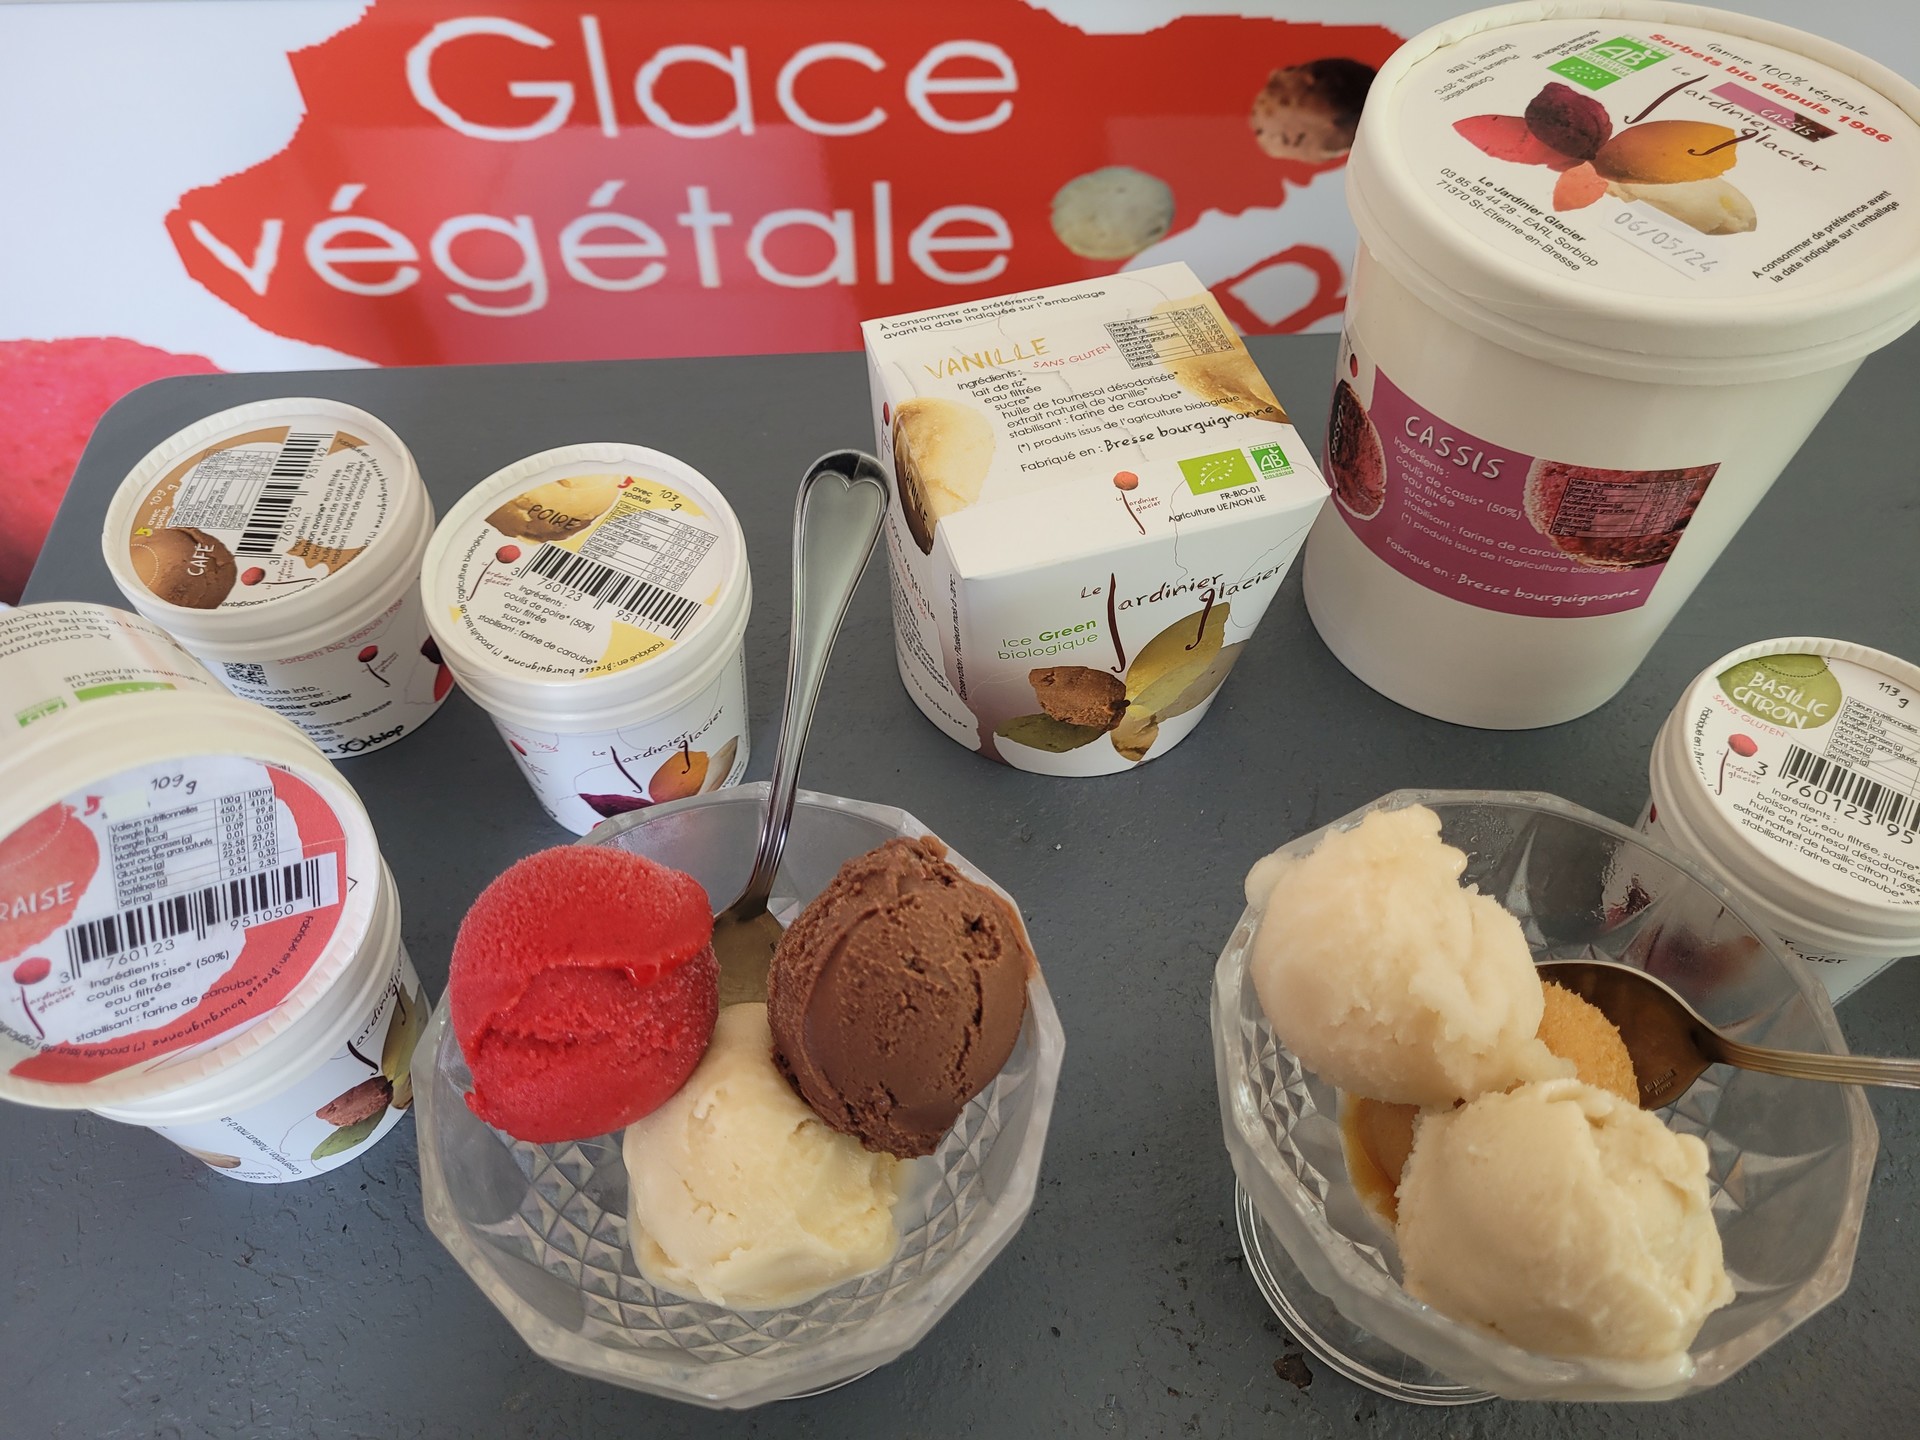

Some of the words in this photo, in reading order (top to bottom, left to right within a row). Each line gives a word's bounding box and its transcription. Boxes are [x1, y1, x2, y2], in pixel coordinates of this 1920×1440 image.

[407, 14, 1019, 141] Glace
[1649, 33, 1723, 68] Sorbets
[1725, 65, 1757, 82] bio
[1762, 81, 1831, 116] depuis
[1837, 114, 1893, 144] 1986
[1671, 66, 1691, 77] Le
[1707, 42, 1753, 67] Gamme
[1760, 63, 1809, 88] 100%
[1808, 85, 1869, 117] végétale
[1759, 107, 1816, 137] CASSIS
[1436, 180, 1470, 201] 71370
[1468, 198, 1581, 272] St-Etienne-en-Bresse
[1440, 167, 1457, 180] 03
[1455, 176, 1470, 188] 85
[1470, 185, 1487, 197] 96
[1485, 195, 1501, 206] 44
[1500, 203, 1516, 215] 28
[1522, 217, 1553, 239] EARL
[1554, 236, 1599, 268] Sorbiop
[1478, 176, 1494, 187] Le
[1494, 184, 1544, 217] Jardinier
[1545, 214, 1586, 242] Glacier
[190, 180, 1014, 317] végétale
[1614, 211, 1718, 274] 06/05/24
[1761, 238, 1812, 274] consommer
[1823, 203, 1870, 234] préférence
[1866, 190, 1892, 207] avant
[1783, 260, 1805, 277] date
[1803, 238, 1840, 264] indiquée
[1850, 200, 1900, 232] l'emballage
[883, 327, 918, 340] avant
[935, 317, 962, 328] date
[965, 306, 1016, 322] indiquée
[1037, 290, 1106, 308] l'emballage
[892, 309, 959, 329] consommer
[981, 294, 1045, 311] préférence
[924, 337, 1051, 379] VANILLE
[1032, 358, 1065, 369] SANS
[1069, 343, 1112, 363] GLUTEN
[971, 386, 991, 398] lait
[993, 383, 1009, 393] de
[984, 393, 1007, 404] eau
[1009, 385, 1042, 399] filtrée
[1002, 405, 1030, 419] huile
[1034, 401, 1050, 411] de
[1051, 388, 1105, 406] tournesol
[1007, 415, 1043, 429] extrait
[1046, 403, 1087, 418] naturel
[1089, 397, 1106, 407] de
[1009, 419, 1062, 439] stabilisant
[1069, 408, 1105, 423] farine
[1108, 403, 1125, 413] de
[1033, 431, 1077, 450] produits
[1078, 424, 1102, 436] issus
[1119, 406, 1183, 425] l'agriculture
[1184, 395, 1240, 412] biologique
[1020, 451, 1076, 472] Fabriqué
[1103, 432, 1155, 452] Bresse
[1156, 405, 1274, 438] bourguignonne
[1394, 436, 1445, 476] Ingrédients
[1405, 415, 1505, 480] CASSIS
[1260, 451, 1285, 471] AB
[622, 490, 652, 506] spatule
[632, 486, 653, 497] avec
[1220, 486, 1261, 500] FR-BIO-01
[1395, 455, 1424, 479] coulis
[1486, 502, 1522, 521] (50%)
[1401, 472, 1423, 489] eau
[1424, 486, 1455, 508] filtrée
[279, 506, 302, 542] 760123
[527, 504, 582, 531] POIRE
[1168, 504, 1216, 523] Agriculture
[1216, 497, 1255, 512] UE/NON
[1403, 499, 1451, 528] stabilisant
[1458, 526, 1494, 546] farine
[1497, 539, 1516, 551] de
[188, 543, 215, 576] CAFÉ
[1413, 521, 1452, 545] produits
[1454, 539, 1478, 555] issus
[1498, 553, 1569, 573] l'agriculture
[1385, 536, 1431, 570] Fabriqué
[1456, 573, 1511, 596] Bresse
[1514, 586, 1641, 607] bourguignonne
[503, 590, 528, 605] coulis
[504, 602, 521, 614] eau
[522, 609, 547, 624] filtrée
[537, 577, 583, 602] 760123
[615, 609, 660, 633] 951111
[1080, 585, 1102, 600] Le
[1185, 562, 1285, 651] glacier
[519, 629, 542, 645] farine
[629, 640, 665, 664] Fabriqué
[998, 632, 1099, 661] biologique
[1002, 635, 1032, 649] Ice
[1039, 620, 1097, 643] Green
[503, 654, 575, 677] bourguignonne
[309, 692, 352, 708] Glacier
[1732, 686, 1808, 729] CITRON
[1750, 671, 1829, 717] BASILIC
[1878, 682, 1901, 697] 113
[1712, 693, 1739, 715] SANS
[1740, 714, 1785, 738] GLUTEN
[151, 773, 184, 790] 109
[1785, 775, 1873, 827] 760123
[221, 804, 244, 815] 450,6
[251, 797, 274, 808] 418,4
[1756, 792, 1797, 817] boisson
[1821, 823, 1844, 838] eau
[1772, 788, 1831, 820] Ingrédients
[222, 839, 246, 850] 25,58
[252, 831, 275, 843] 23,75
[1733, 803, 1764, 821] extrait
[1765, 818, 1802, 841] naturel
[1820, 843, 1856, 867] basilic
[1857, 861, 1889, 882] citron
[1741, 817, 1794, 848] stabilisant
[1799, 845, 1831, 867] farine
[1749, 799, 1775, 817] huile
[1797, 821, 1849, 852] tournesol
[106, 939, 175, 969] 760123
[230, 903, 294, 931] 951050
[86, 985, 125, 1002] coulis
[129, 977, 147, 989] de
[196, 950, 229, 969] (50%)
[90, 962, 160, 989] Ingrédients
[105, 994, 132, 1009] eau
[135, 981, 172, 998] filtrée
[76, 1016, 133, 1042] stabilisant
[142, 1002, 178, 1020] farine
[181, 996, 198, 1006] de
[152, 998, 247, 1046] bourguignonne
